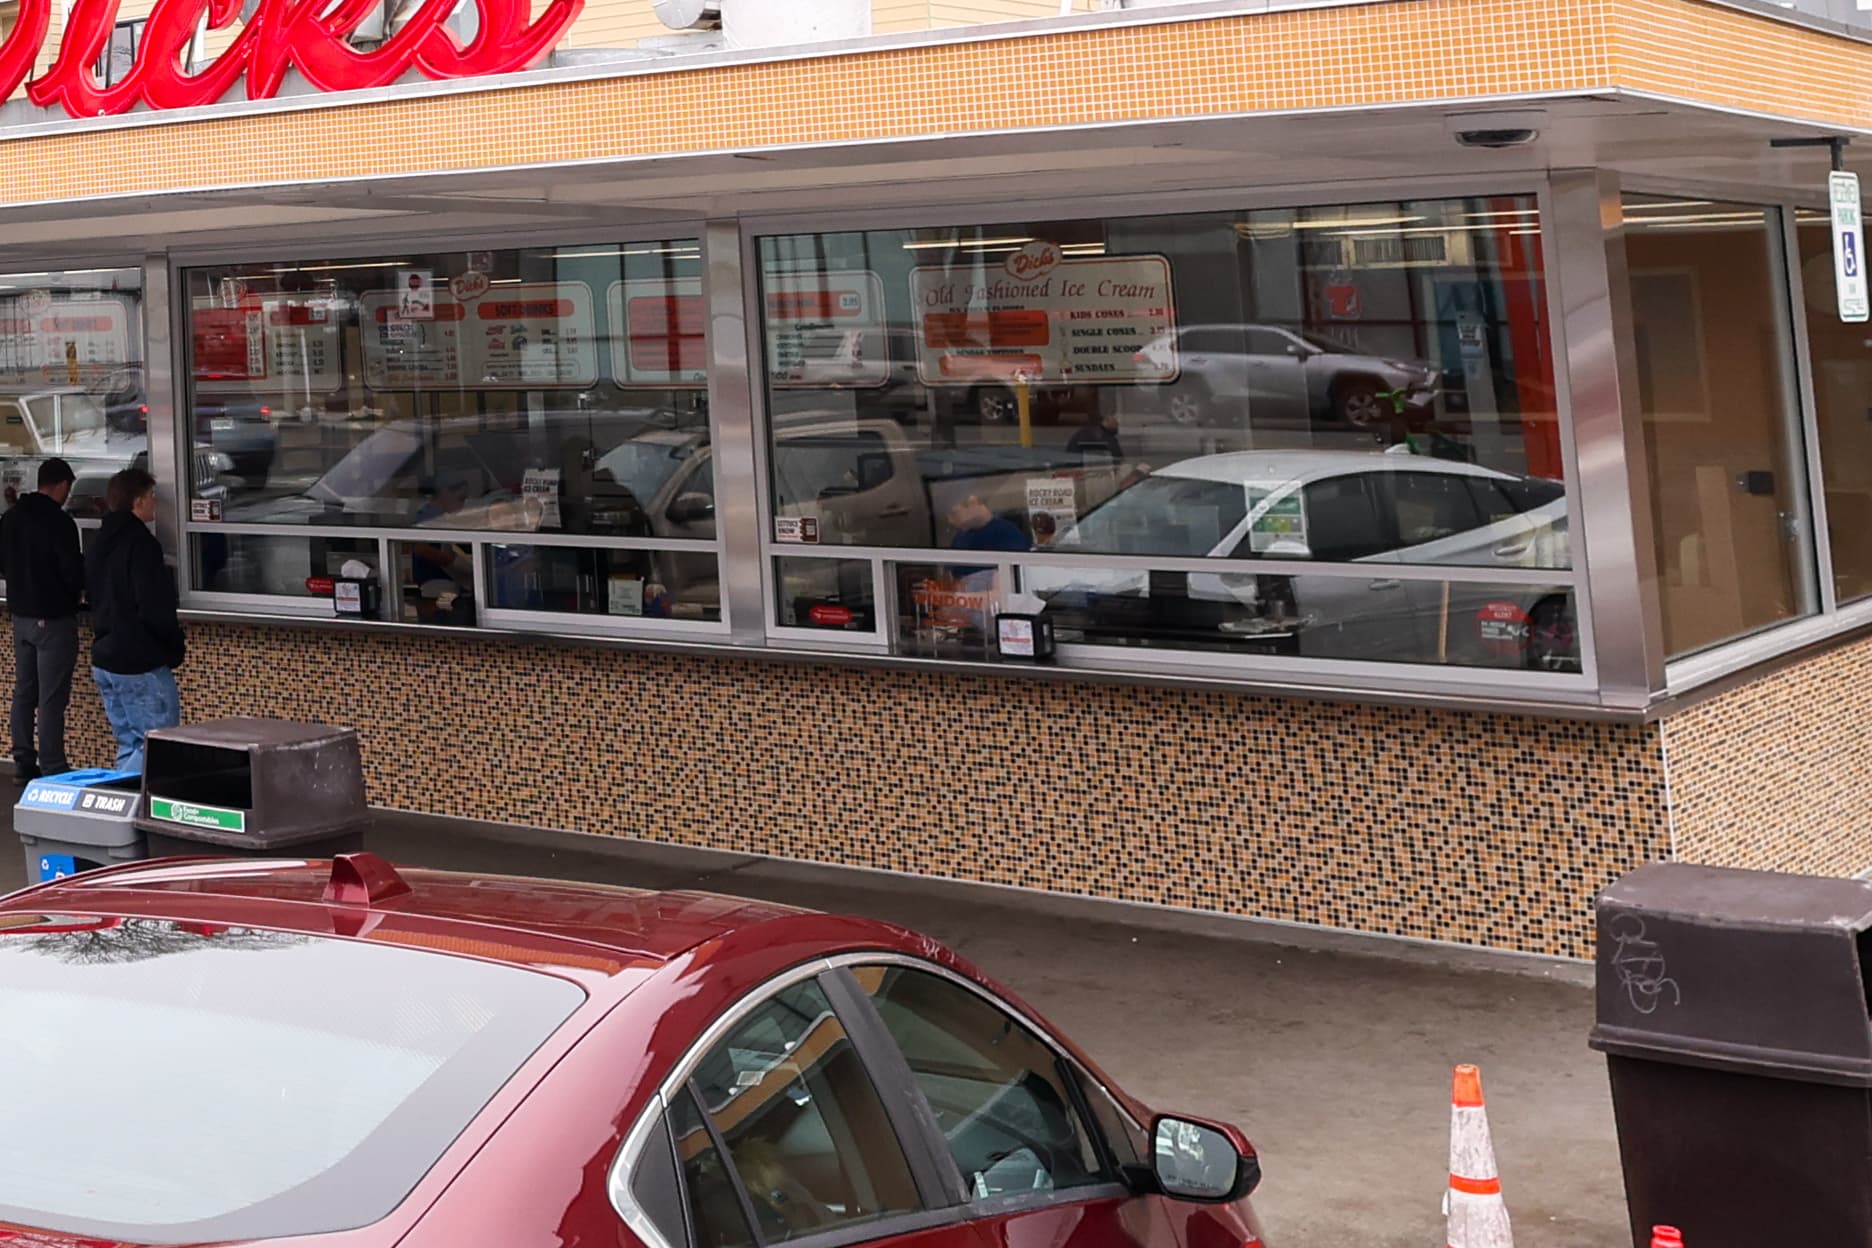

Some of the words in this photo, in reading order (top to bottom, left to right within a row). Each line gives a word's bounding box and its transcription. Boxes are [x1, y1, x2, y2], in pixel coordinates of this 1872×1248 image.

[925, 285, 954, 306] Old
[1060, 279, 1085, 298] Ice
[1097, 279, 1156, 299] Cream
[1070, 310, 1092, 320] KIDS
[1095, 310, 1125, 319] CONES
[1071, 328, 1103, 337] SINGLE
[1106, 327, 1137, 336] CONES
[1073, 345, 1108, 354] DOUBLE
[38, 789, 75, 805] RECYCLE
[94, 796, 126, 812] TRASH
